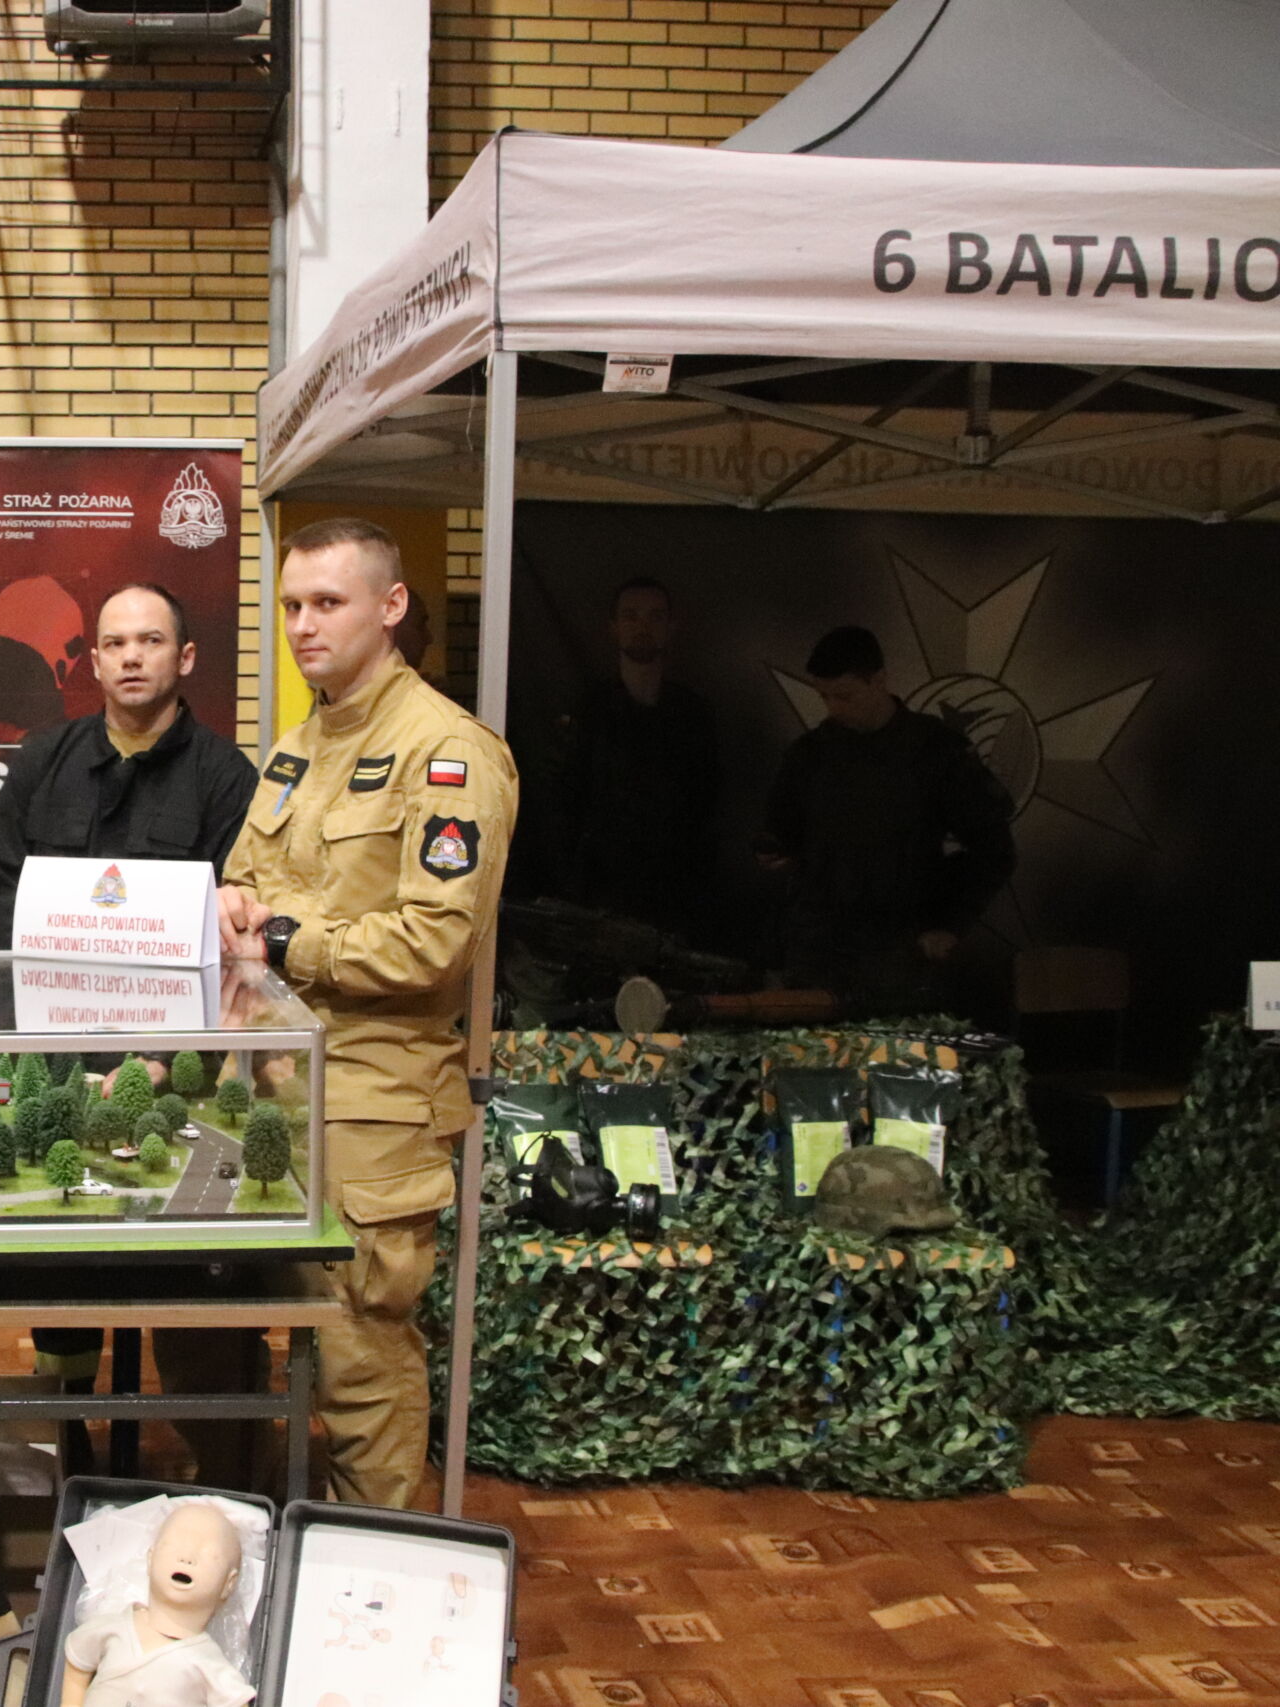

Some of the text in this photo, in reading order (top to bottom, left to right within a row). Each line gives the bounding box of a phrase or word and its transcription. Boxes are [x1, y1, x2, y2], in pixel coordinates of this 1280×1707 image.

[873, 229, 1280, 302] 6 BATALIO
[3, 492, 52, 508] STRAŻ
[59, 492, 132, 508] POŻARNA
[5, 530, 35, 540] ŚREMIE
[47, 913, 165, 933] KOMENDA POWIATOWA
[21, 933, 191, 958] PAŃSTWOWEJ STRAŻY POŻARNEJ
